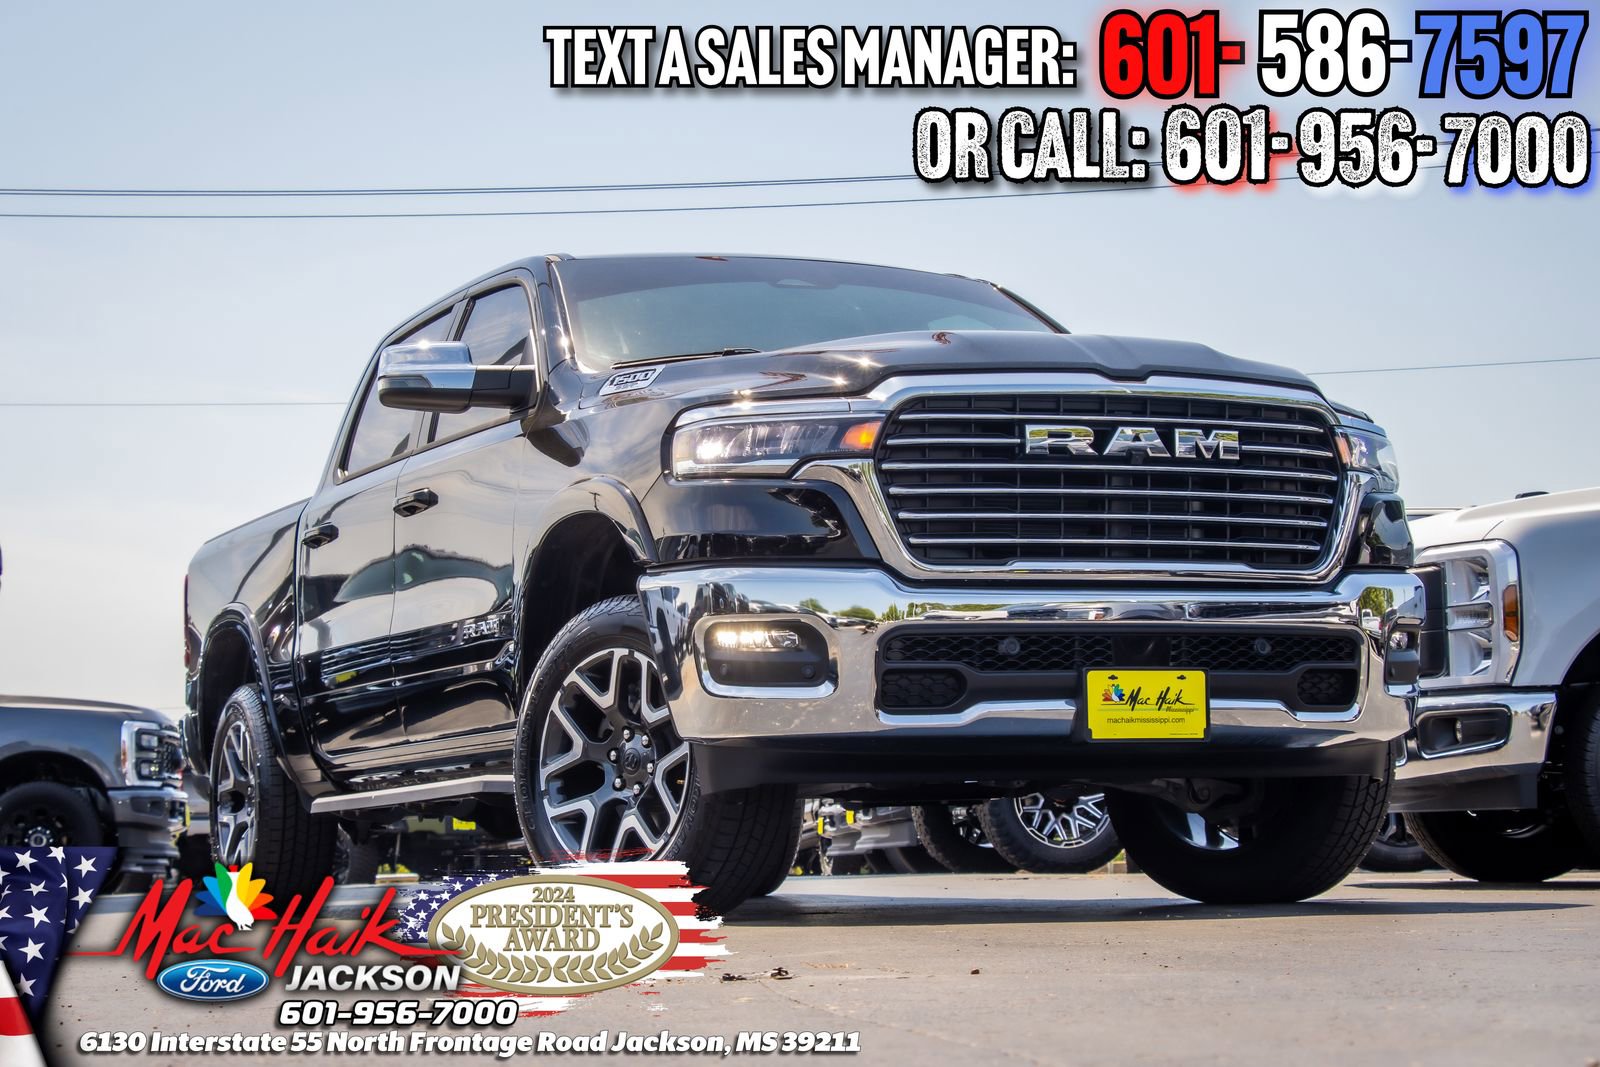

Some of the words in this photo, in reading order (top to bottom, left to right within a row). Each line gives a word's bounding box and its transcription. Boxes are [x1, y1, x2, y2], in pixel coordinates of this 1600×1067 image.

[609, 368, 656, 386] 1500
[1025, 424, 1240, 460] RAM
[463, 618, 500, 639] RAM
[1125, 686, 1152, 711] Mac
[1155, 686, 1195, 711] Haik
[1106, 716, 1186, 725] machaikmississippi.com
